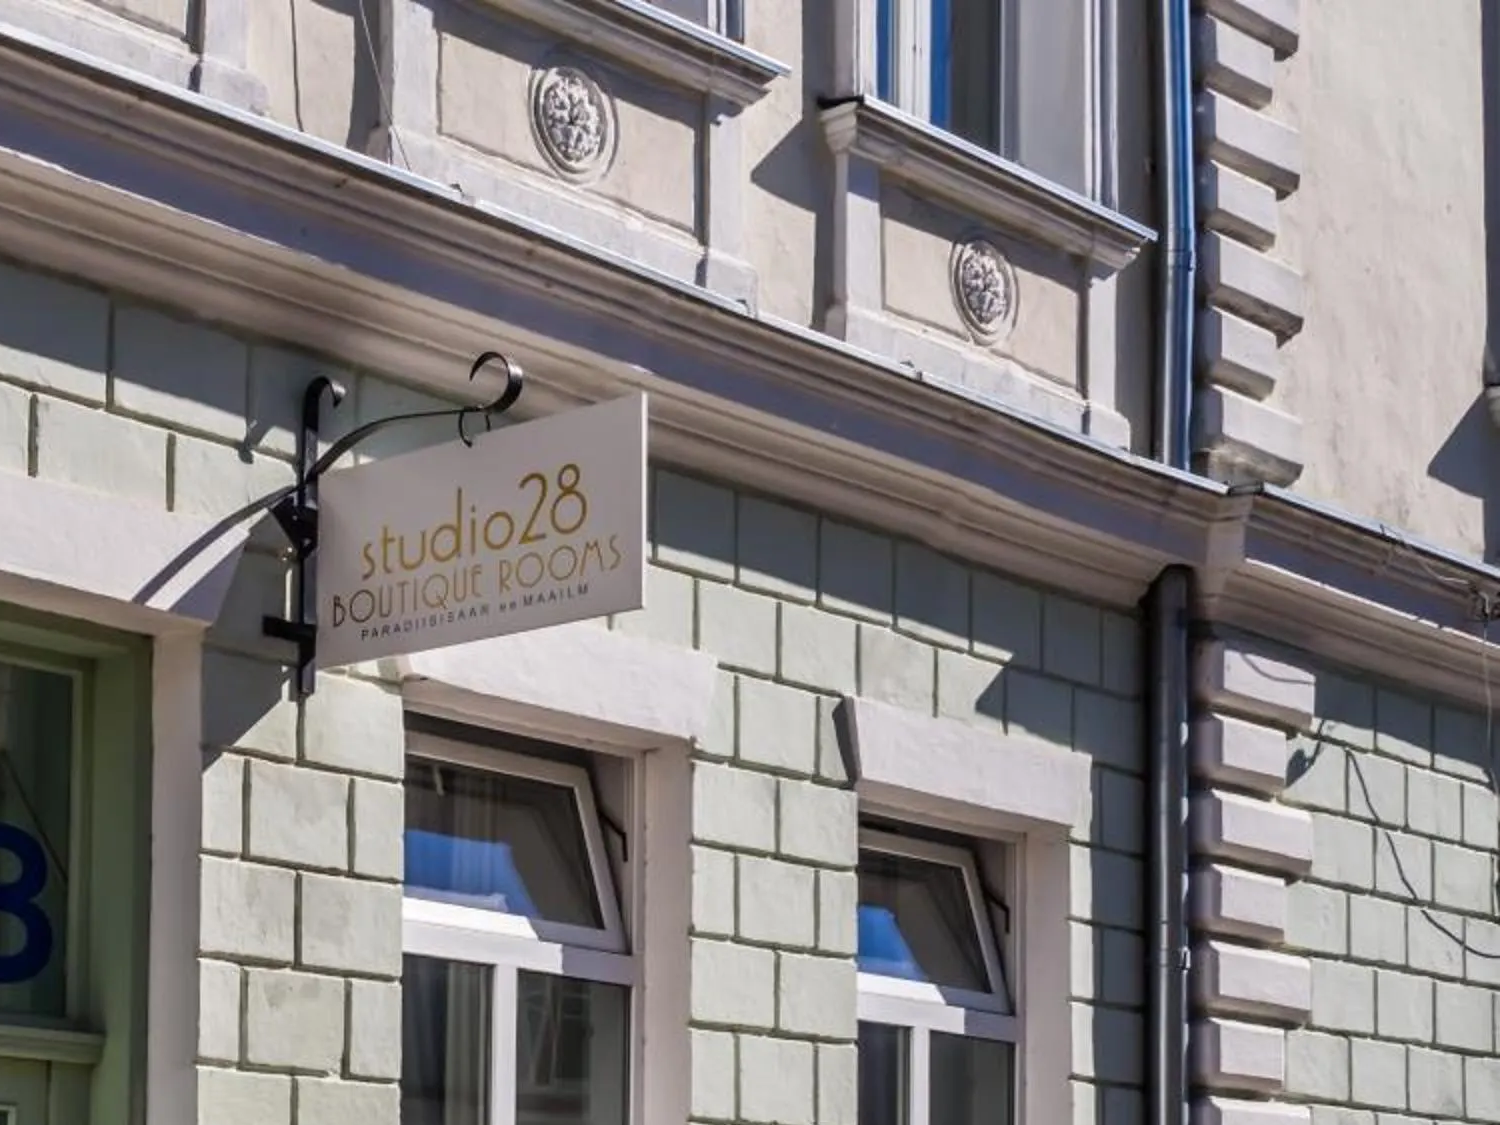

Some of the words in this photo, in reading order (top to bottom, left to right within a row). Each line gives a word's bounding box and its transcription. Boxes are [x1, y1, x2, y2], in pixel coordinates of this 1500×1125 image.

[361, 463, 588, 580] studio28
[332, 563, 484, 628] BOUTIQUE
[498, 534, 622, 592] ROOMS
[522, 583, 590, 608] MAAILM
